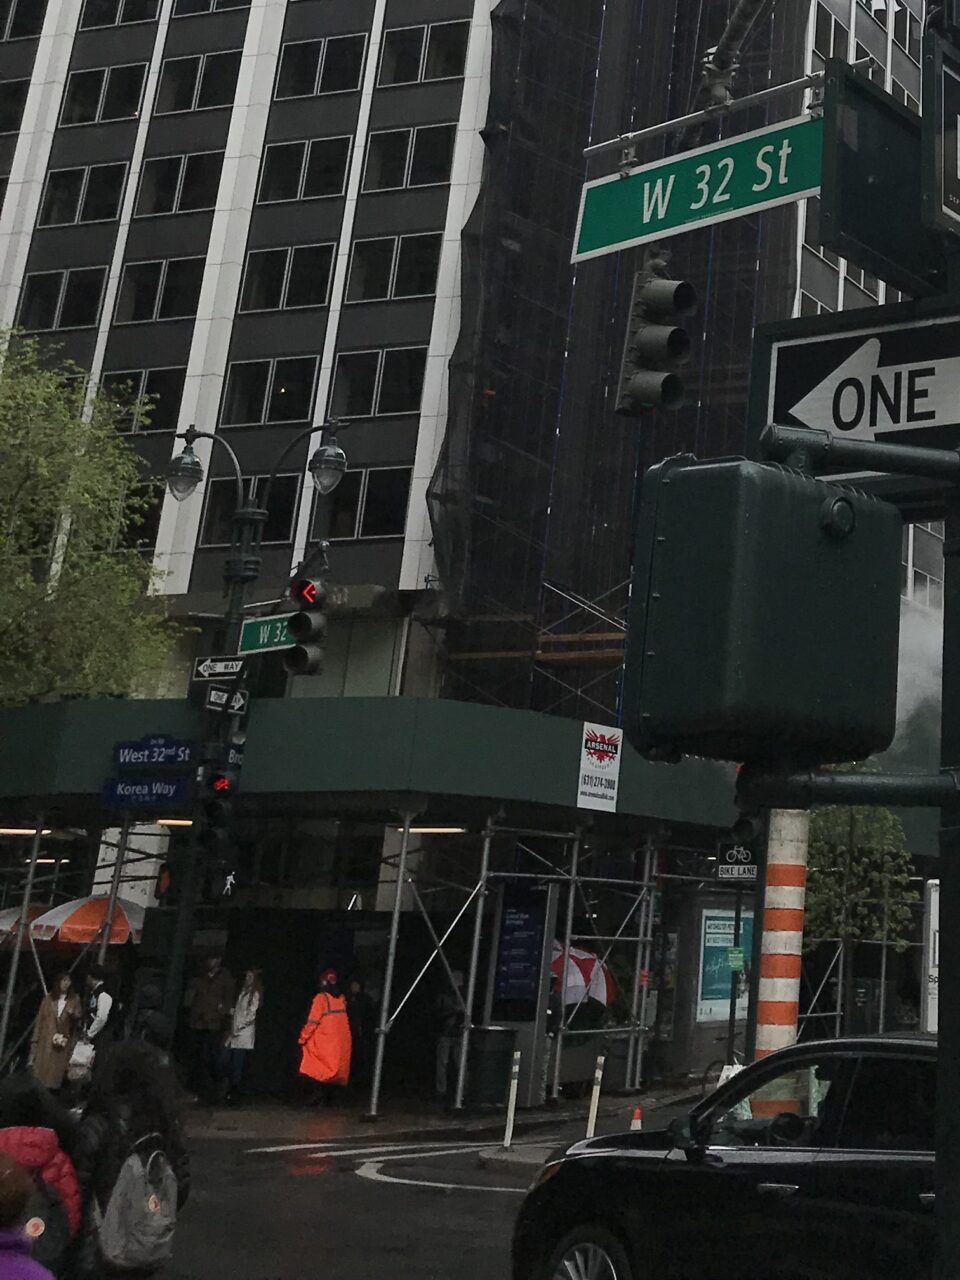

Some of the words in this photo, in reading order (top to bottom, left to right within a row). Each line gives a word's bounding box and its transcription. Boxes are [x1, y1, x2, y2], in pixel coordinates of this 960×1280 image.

[643, 174, 675, 224] W
[690, 157, 734, 210] 32
[752, 139, 792, 192] St
[832, 367, 936, 431] ONE
[260, 624, 271, 644] W
[202, 664, 218, 672] ONE
[223, 663, 240, 671] WAY
[119, 748, 149, 762] West
[151, 746, 176, 762] 32nd
[177, 747, 191, 761] St
[586, 740, 616, 753] ARSENAL
[116, 783, 148, 795] Korea
[151, 782, 176, 796] Way
[719, 865, 735, 876] BIKE
[738, 865, 756, 876] LANE
